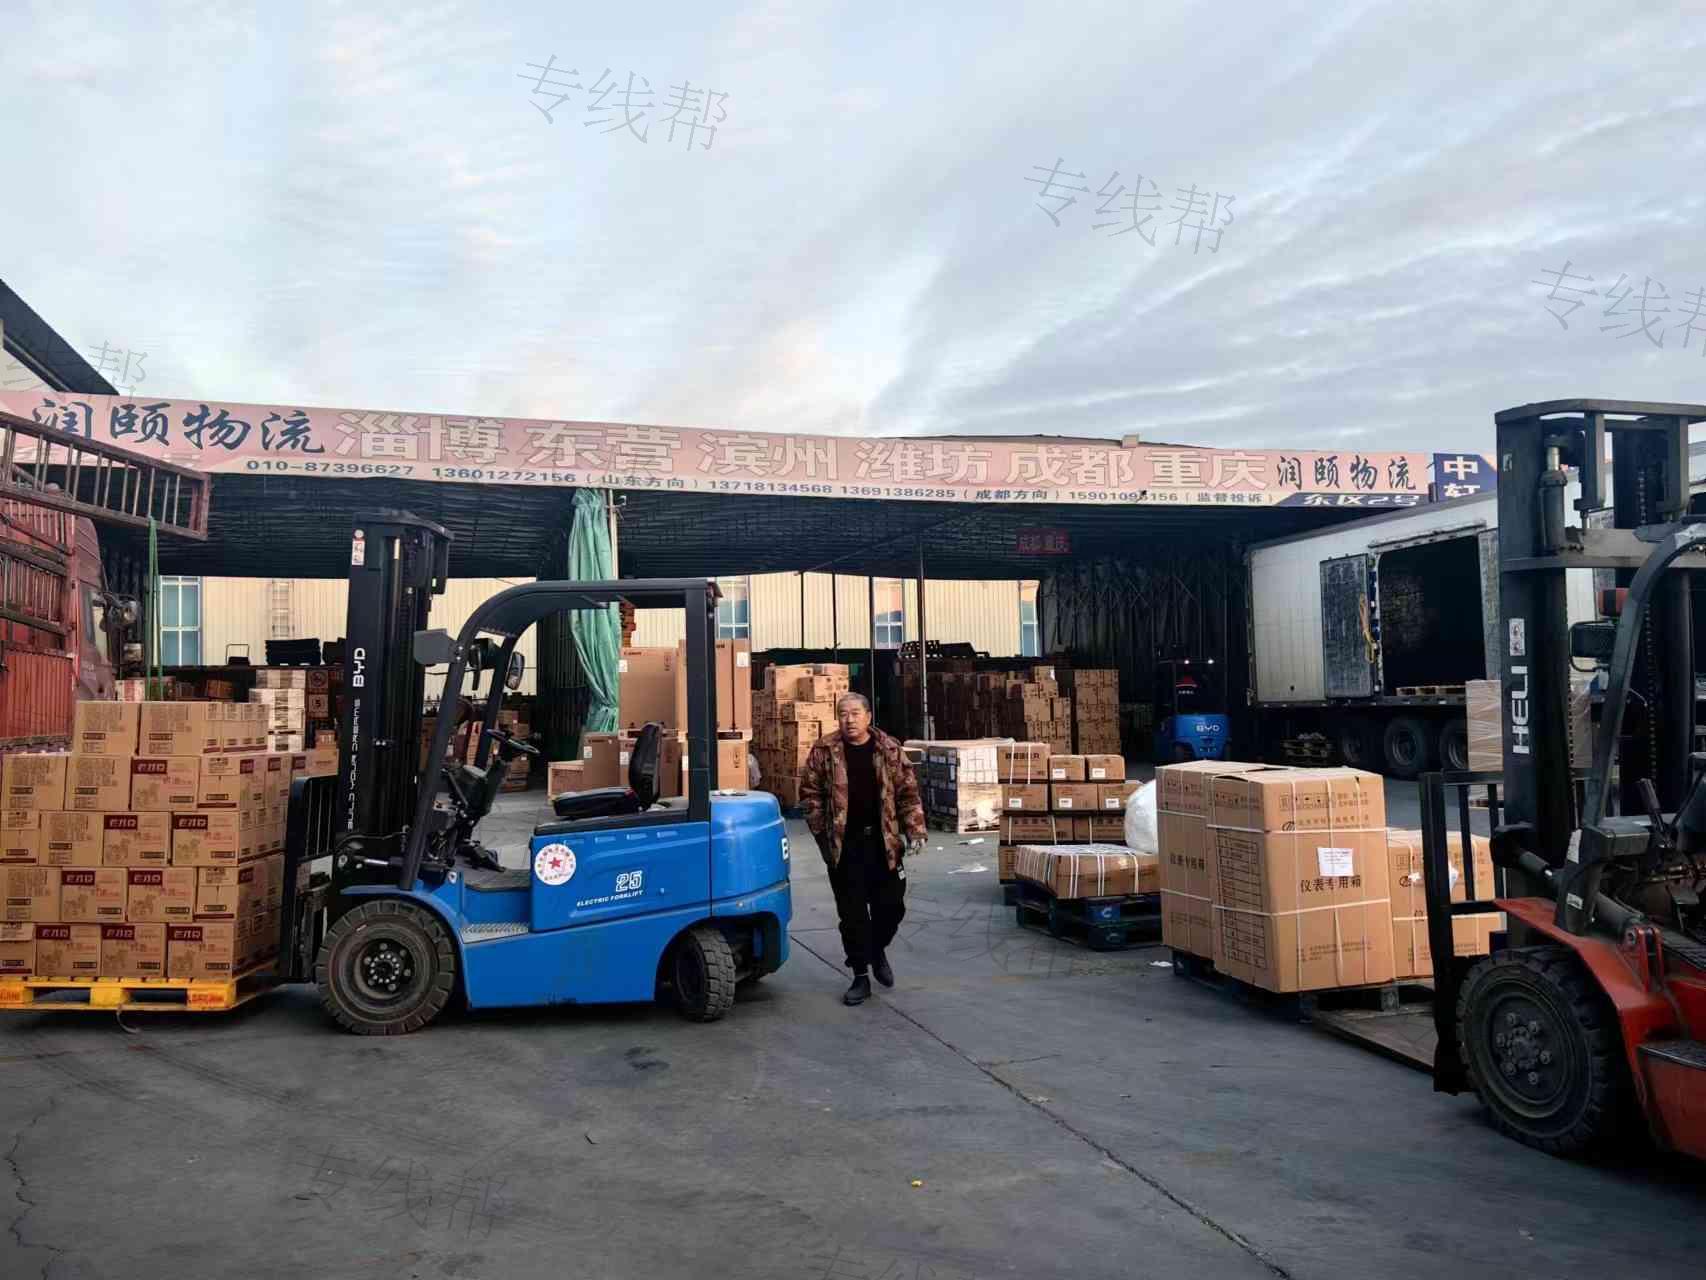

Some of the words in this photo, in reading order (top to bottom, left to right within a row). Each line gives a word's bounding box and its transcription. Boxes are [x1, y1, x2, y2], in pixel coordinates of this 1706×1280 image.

[336, 412, 509, 465] 淄博
[520, 422, 681, 474] 东营
[697, 431, 839, 480] 滨州
[855, 439, 992, 486] 潍坊
[1006, 448, 1134, 487] 成都
[1145, 448, 1268, 490] 重庆
[1277, 455, 1416, 490] 润颐物流
[1443, 456, 1479, 480] 中
[246, 460, 414, 475] 010-87396627
[432, 467, 576, 483] 13601272156
[709, 480, 833, 494] 13718134568
[840, 486, 956, 498] 13691386285
[353, 648, 366, 687] BYD
[1511, 665, 1530, 755] HELI
[576, 896, 609, 907] ELECTRIC
[610, 890, 643, 902] FORKLIFT
[615, 870, 643, 892] 25
